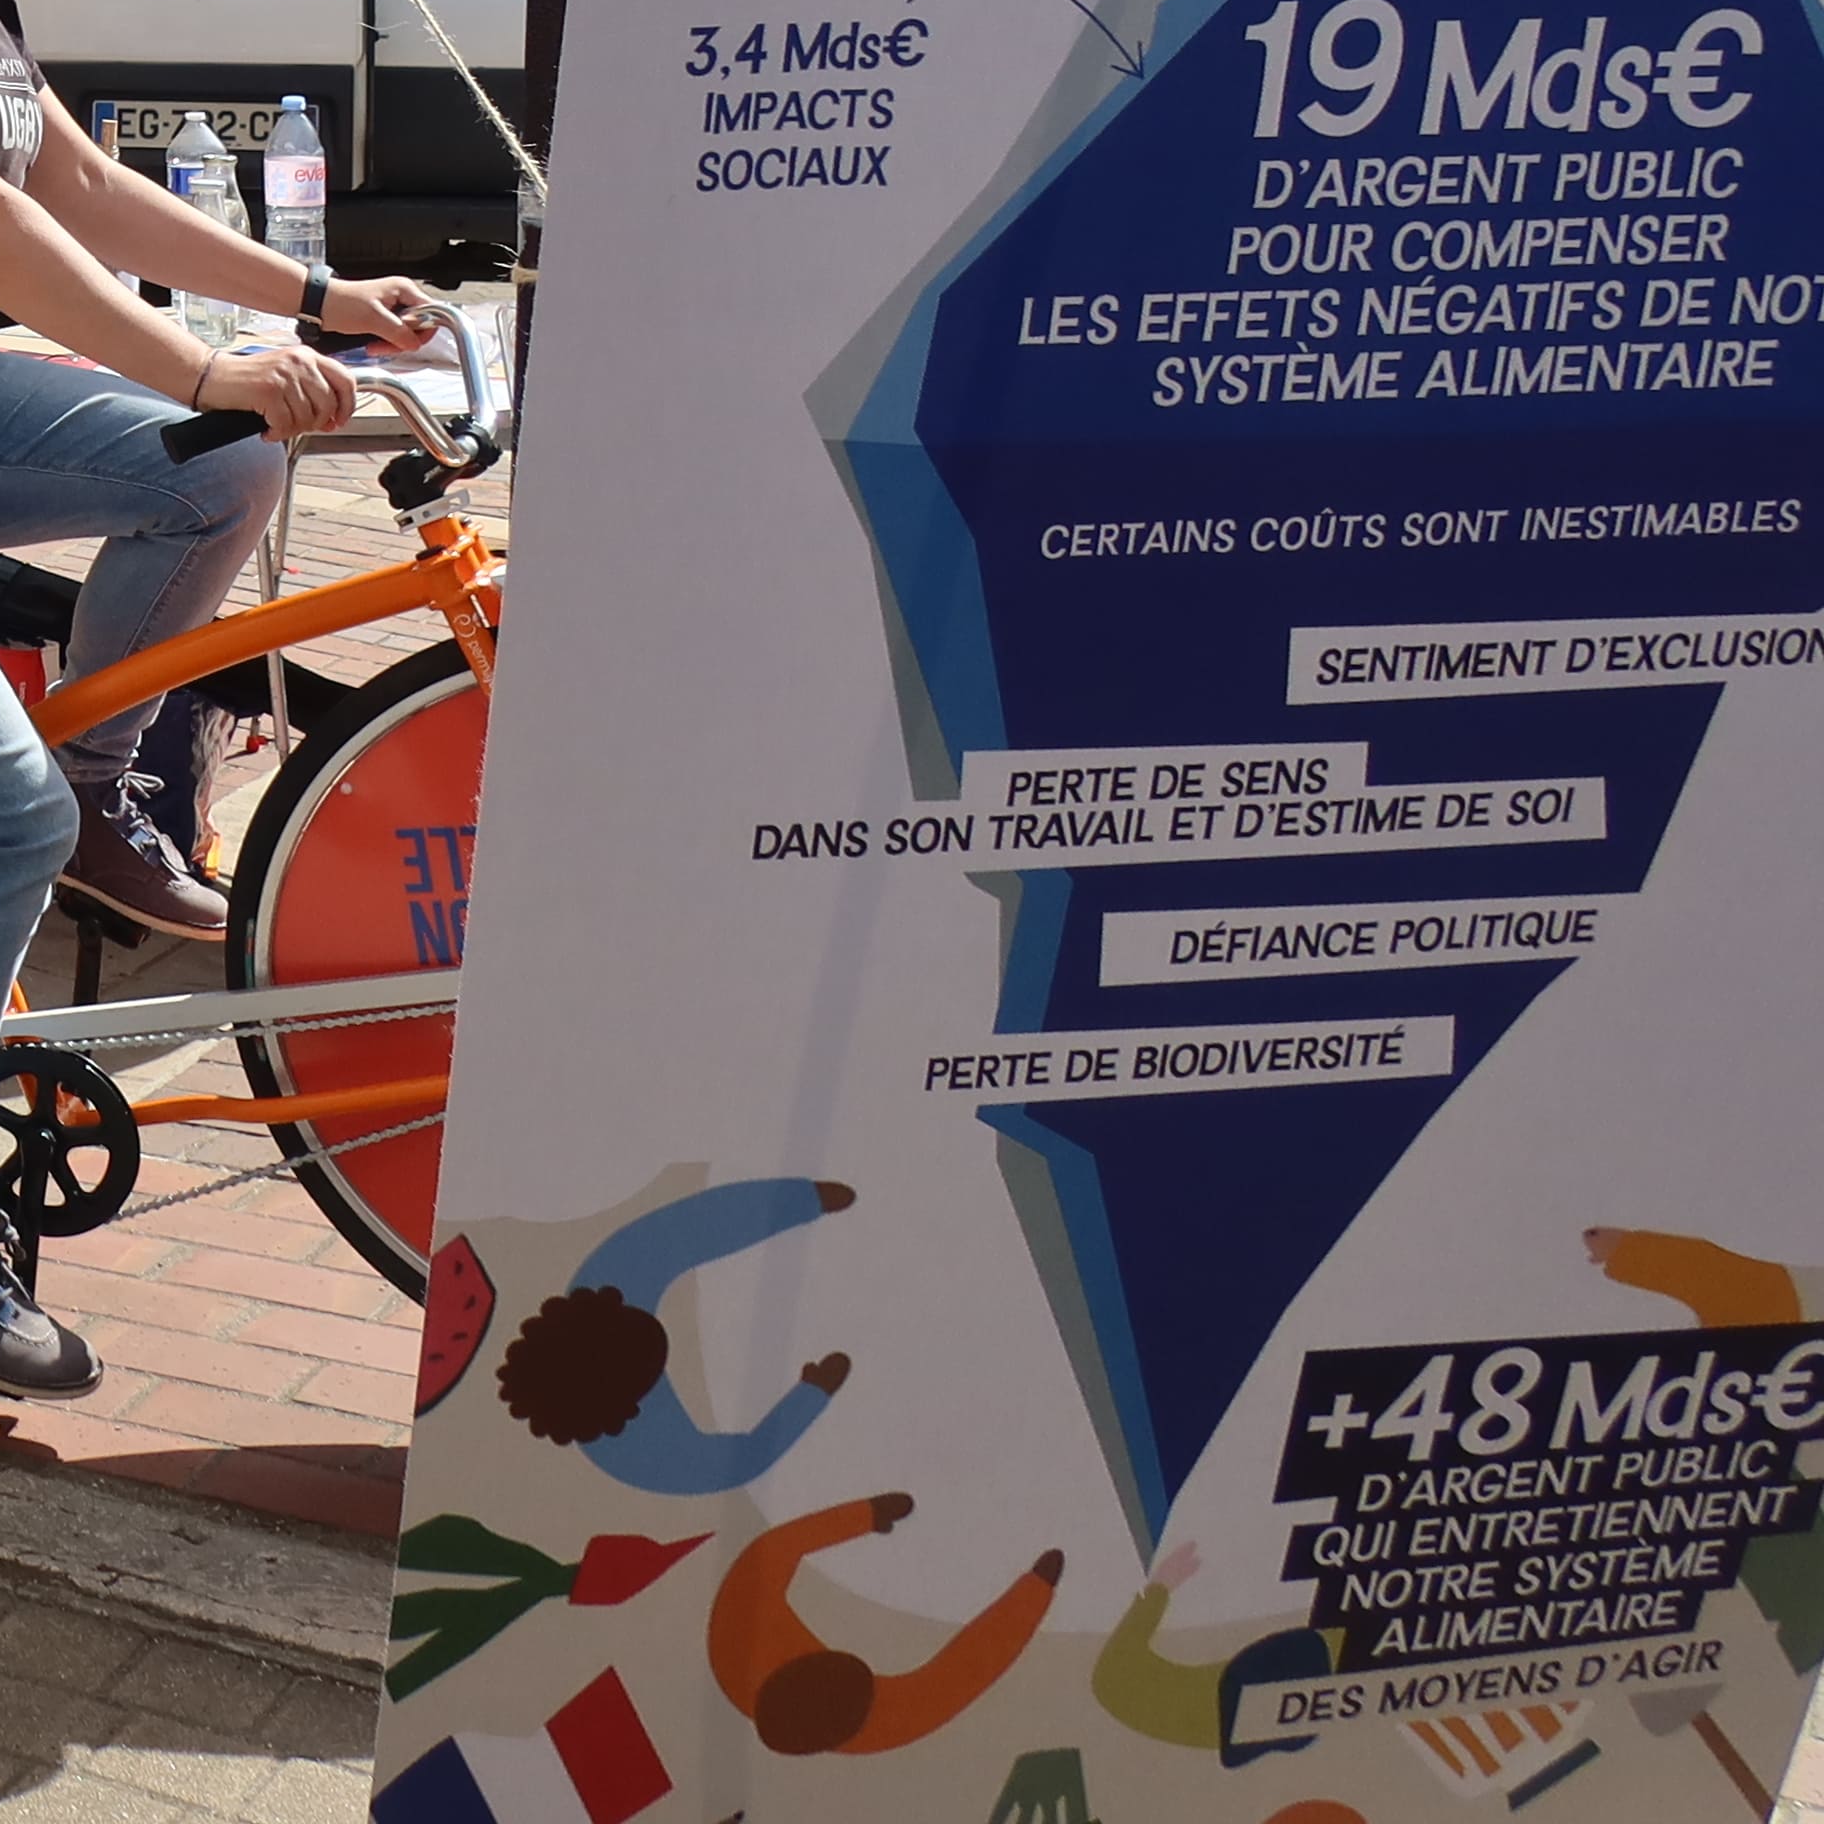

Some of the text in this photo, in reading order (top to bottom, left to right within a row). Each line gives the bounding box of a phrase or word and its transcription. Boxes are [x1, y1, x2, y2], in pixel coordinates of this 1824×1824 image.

[686, 19, 928, 79] 3,4 Mds€
[1421, 7, 1764, 138] Mds€
[704, 89, 894, 134] IMPACTS
[697, 146, 890, 192] SOCIAUX
[1253, 148, 1744, 210] D'ARGENT PUBLIC
[1227, 214, 1730, 275] POUR COMPENSER
[1019, 294, 1118, 346] LES
[1137, 288, 1340, 344] EFFETS
[1358, 276, 1624, 338] NÉGATIFS
[1640, 278, 1714, 328] DE
[1153, 338, 1780, 407] SYSTÈME ALIMENTAIRE
[1040, 499, 1800, 560] CERTAINS COÛTS SONT INESTIMABLES
[1315, 639, 1554, 687] SENTIMENT
[1007, 759, 1329, 807] PERTE DE SENS
[753, 788, 1574, 860] DANS SON TRAVAIL ET D'ESTIME DE SOI
[1170, 908, 1598, 965] DÉFIANCE POLITIQUE
[925, 1028, 1406, 1091] PERTE DE BIODIVERSITÉ
[1307, 1339, 1824, 1462] +48 Mds€
[1357, 1439, 1777, 1513] D'ARGENT PUBLIC
[1313, 1485, 1797, 1568] QUI ENTRETIENNENT
[1340, 1537, 1725, 1611] NOTRE SYSTÈME
[1373, 1590, 1683, 1656] ALIMENTAIRE
[1278, 1640, 1724, 1725] DES MOYENS D'AGIR
